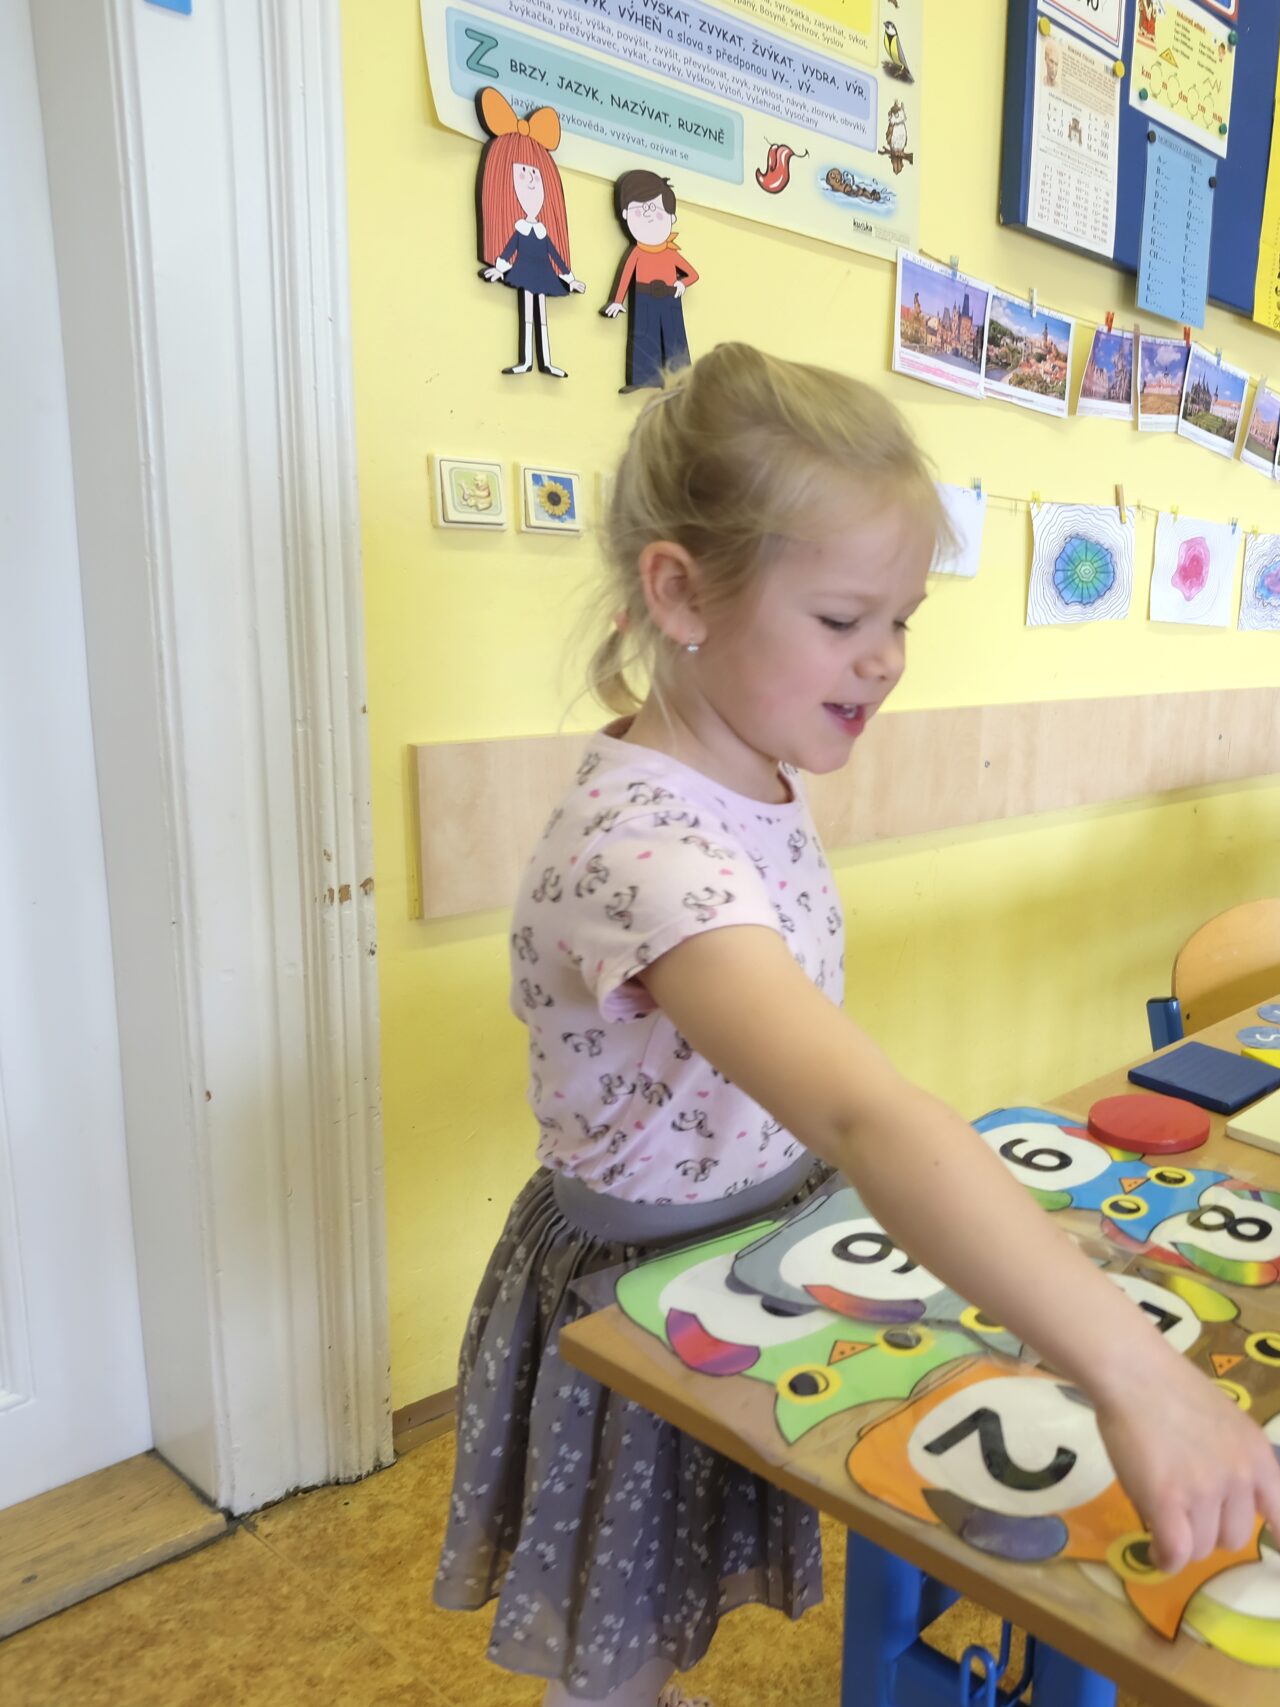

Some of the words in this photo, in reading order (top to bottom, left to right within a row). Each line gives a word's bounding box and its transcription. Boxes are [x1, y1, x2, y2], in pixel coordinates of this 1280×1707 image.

[464, 28, 500, 79] Z
[509, 1, 556, 29] žvýkačka,
[559, 22, 619, 52] přežvýkavec,
[622, 45, 649, 63] vykat,
[686, 67, 716, 89] Vyškov,
[746, 92, 783, 114] Vyšehrad,
[785, 106, 819, 128] Vysočany
[617, 30, 652, 51] povýšit,
[683, 56, 728, 81] převyšovat,
[667, 29, 674, 39] a
[678, 31, 703, 50] slova
[707, 45, 712, 55] s
[716, 49, 768, 78] předponou
[699, 19, 745, 51] ZVYKAT,
[752, 39, 796, 72] ŽVÝKAT,
[802, 64, 840, 89] VYDRA,
[845, 80, 868, 101] VÝR,
[1141, 65, 1152, 80] km
[509, 58, 549, 86] BRZY,
[557, 76, 603, 104] JAZYK,
[610, 94, 672, 128] NAZÝVAT,
[678, 117, 725, 145] RUZYNĚ
[1179, 91, 1188, 103] dm
[610, 130, 648, 148] vyzývat,
[650, 140, 677, 158] ozývat
[679, 152, 689, 160] se
[1187, 1204, 1272, 1242] 8
[923, 1407, 1077, 1492] 2
